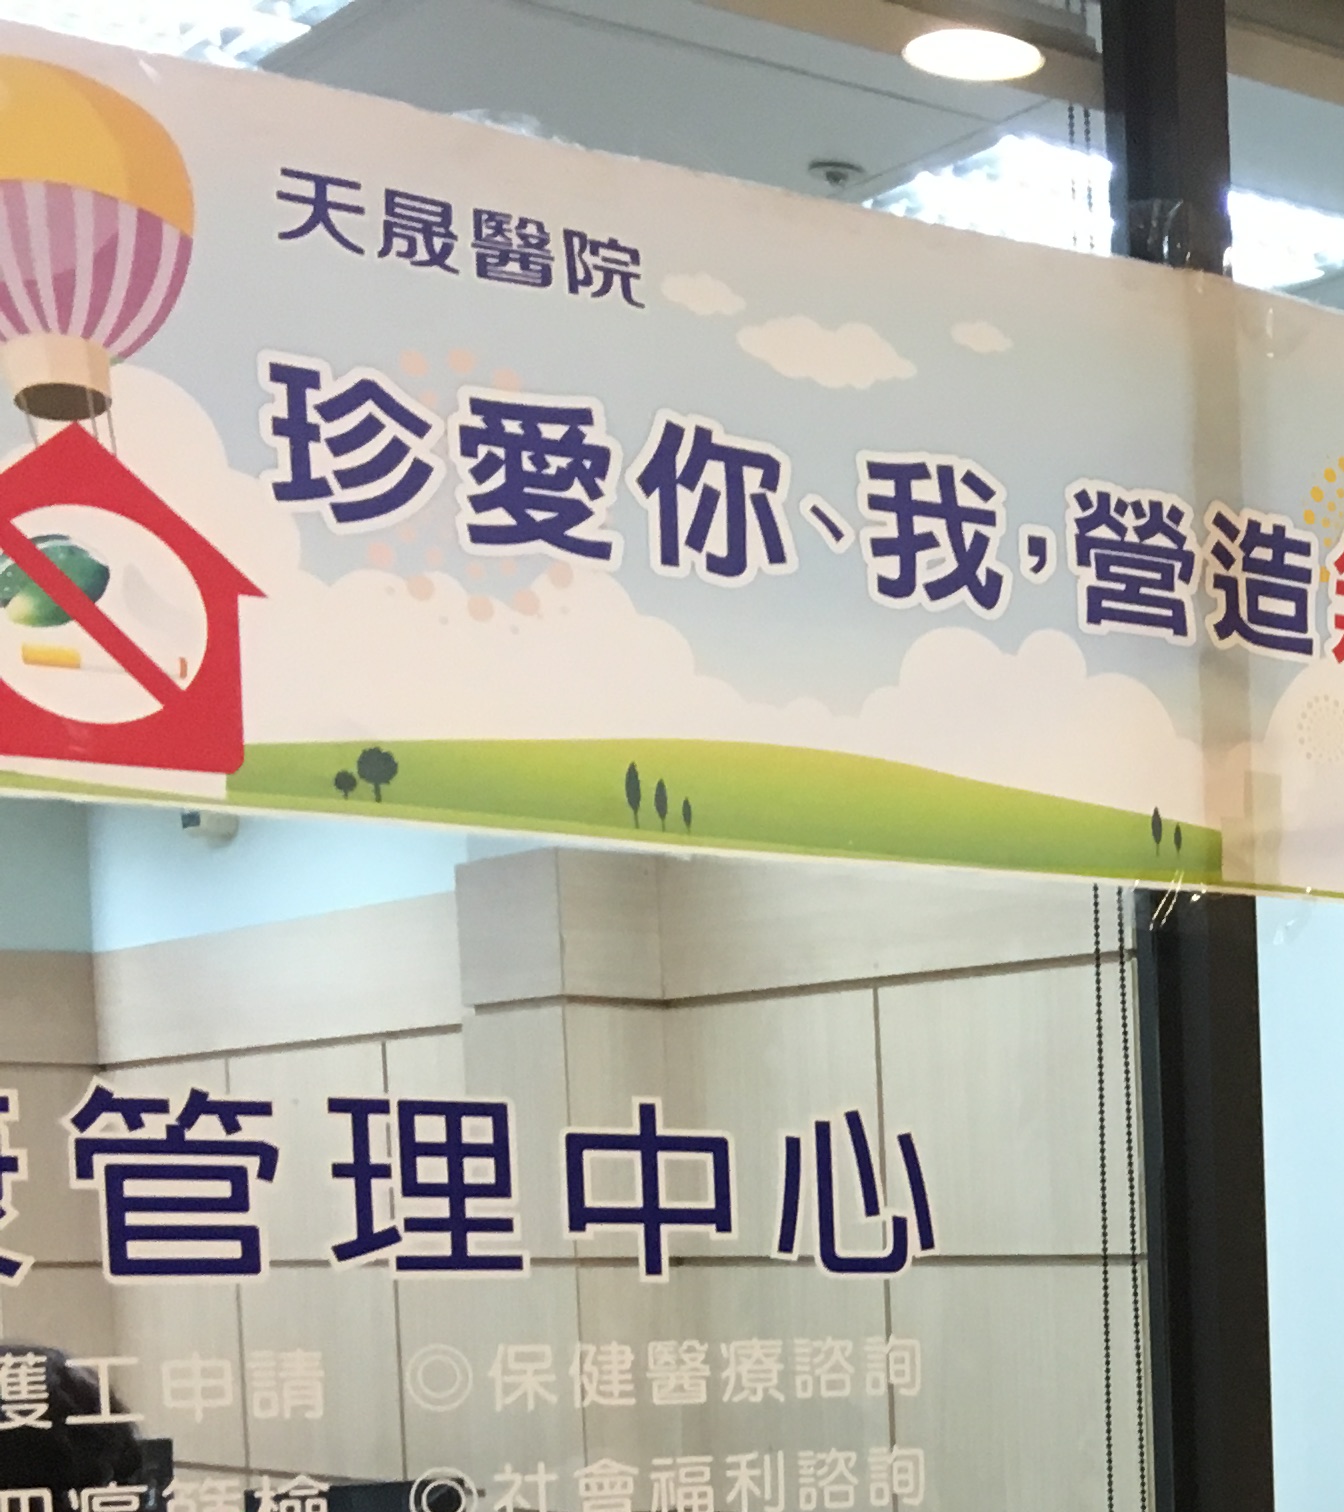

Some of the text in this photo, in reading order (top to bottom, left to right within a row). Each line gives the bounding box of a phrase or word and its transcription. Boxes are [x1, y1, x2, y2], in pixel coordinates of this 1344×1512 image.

[277, 168, 646, 308] 天晟醫院
[0, 1088, 936, 1279] 管理中心
[487, 1334, 925, 1412] 保健醫療諮詢
